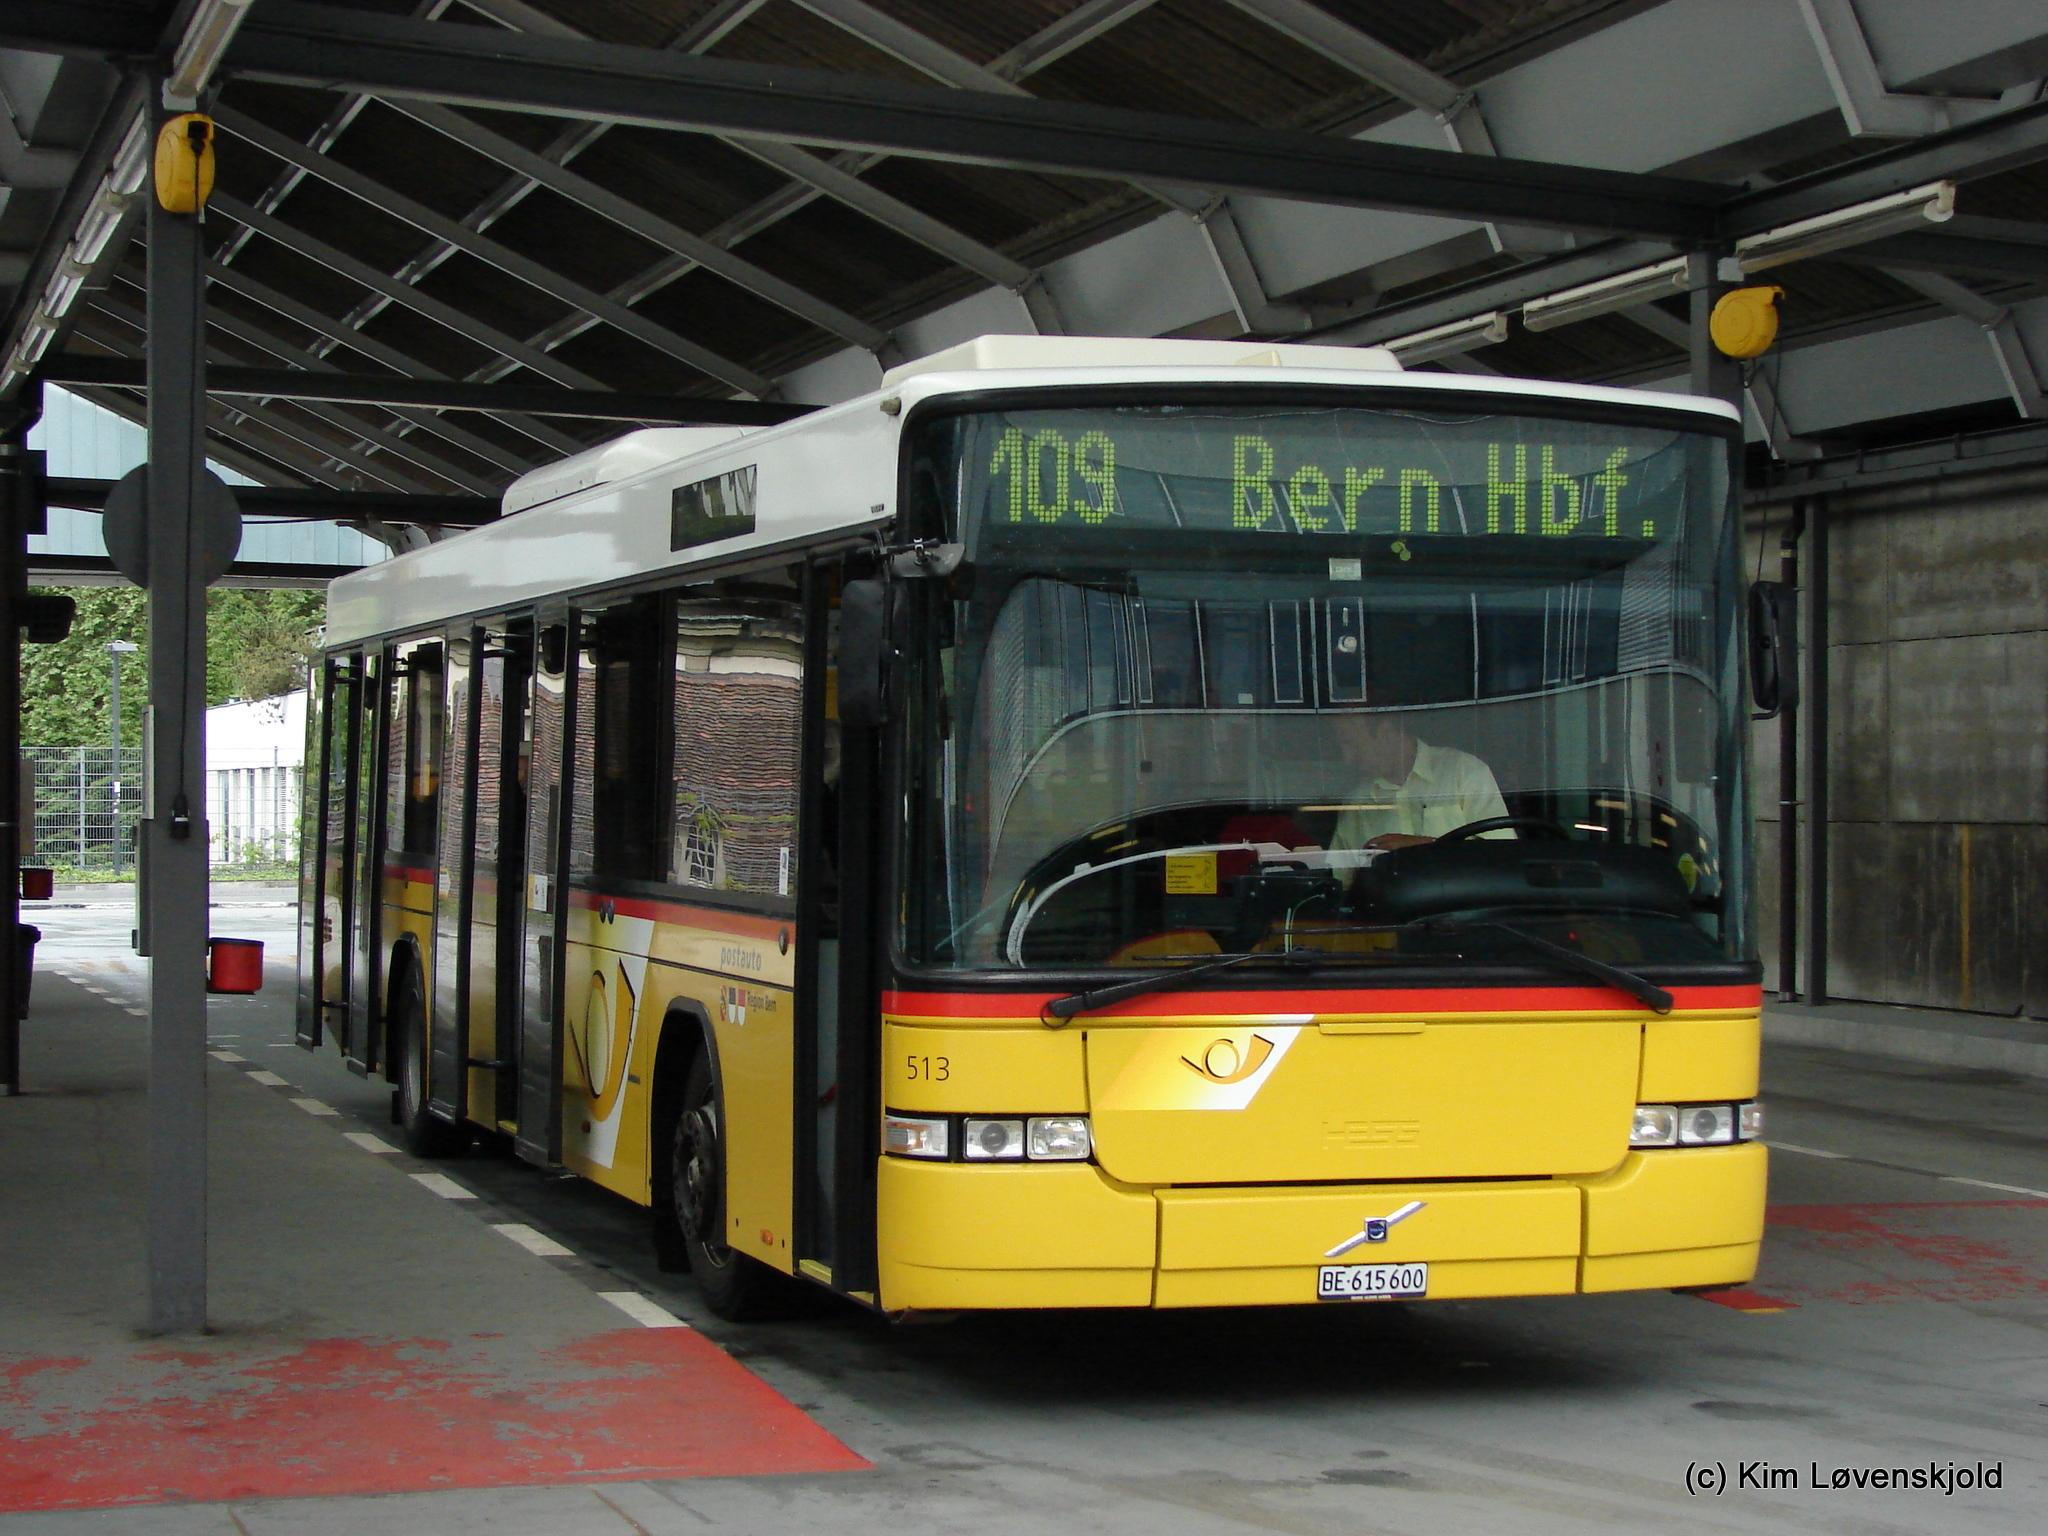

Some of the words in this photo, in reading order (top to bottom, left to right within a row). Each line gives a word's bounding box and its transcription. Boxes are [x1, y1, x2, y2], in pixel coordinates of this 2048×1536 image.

[989, 427, 1116, 524] 109
[1234, 434, 1442, 533] Bern
[1487, 442, 1656, 537] Hbf.
[720, 945, 762, 971] postauto
[907, 1055, 950, 1082] 513
